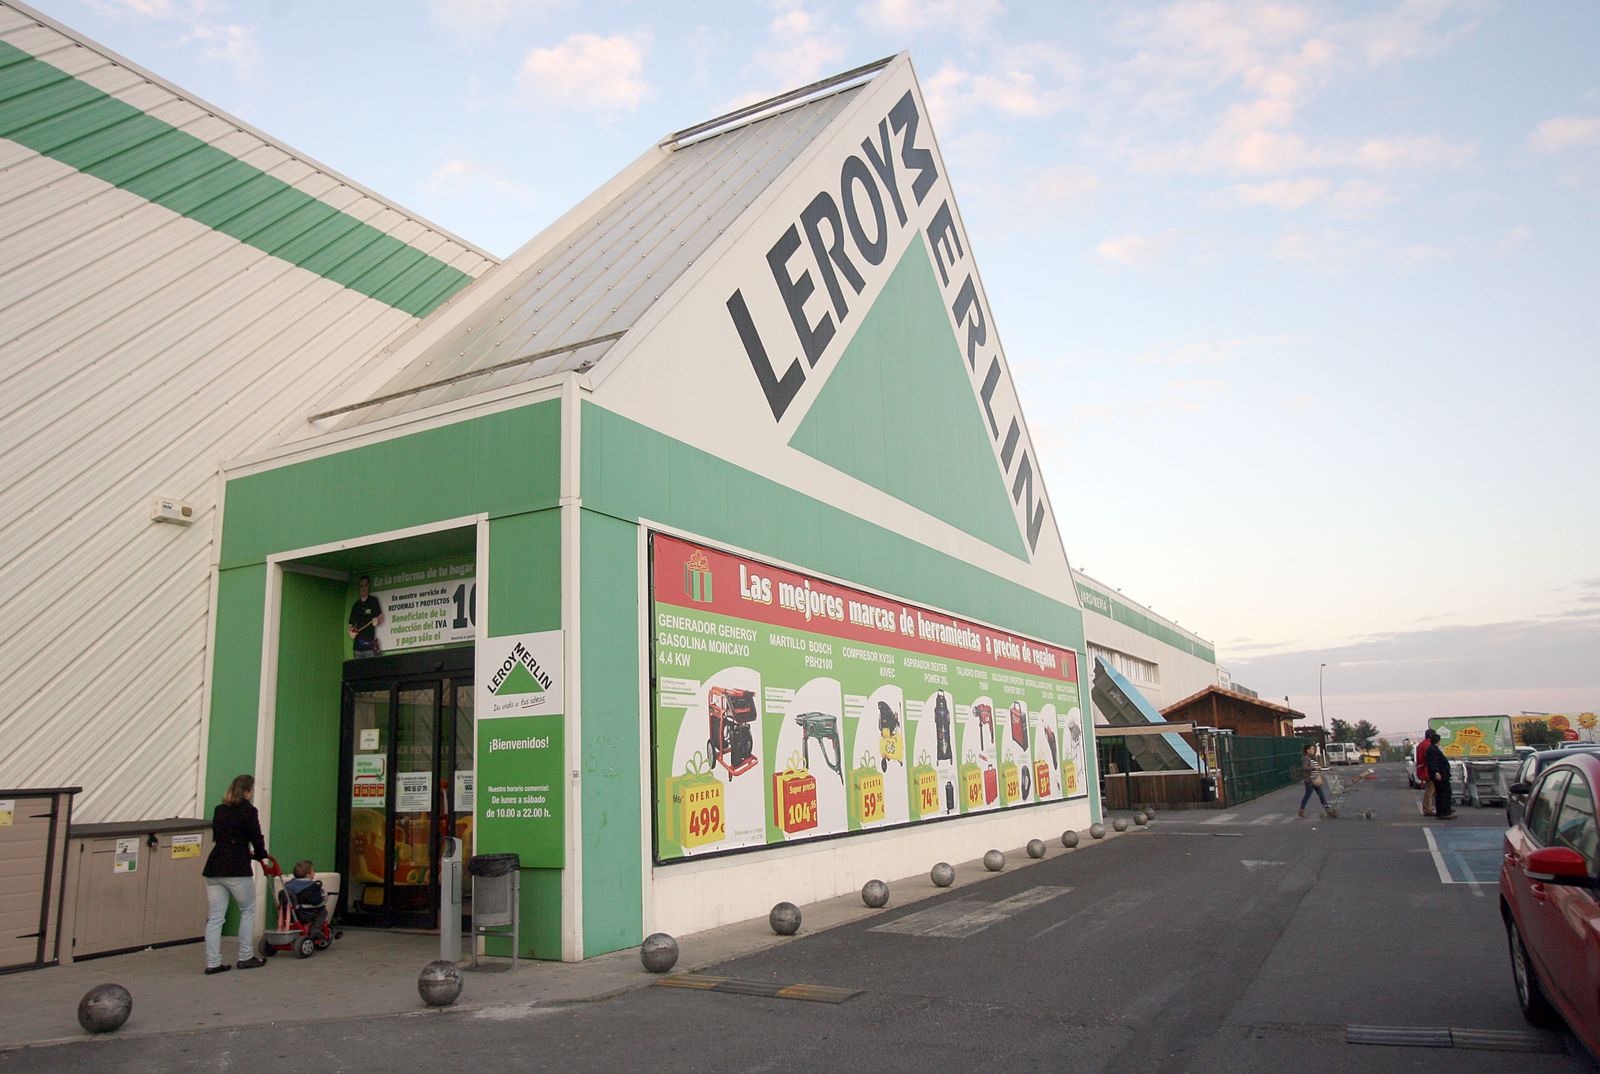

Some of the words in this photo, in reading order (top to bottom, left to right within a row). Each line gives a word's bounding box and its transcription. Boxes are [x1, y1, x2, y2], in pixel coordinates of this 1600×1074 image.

[726, 117, 909, 423] LEROY
[887, 88, 1046, 555] MERLIN
[385, 574, 392, 585] la
[394, 571, 426, 584] reforma
[426, 568, 438, 578] de
[439, 566, 448, 576] tu
[449, 564, 474, 576] hogar
[420, 589, 440, 598] servicio
[388, 602, 414, 612] REFORMAS
[420, 597, 450, 608] PROYECTOS
[430, 609, 438, 618] de
[439, 608, 446, 616] la
[738, 564, 772, 605] Las
[778, 579, 845, 622] mejores
[848, 600, 896, 632] marcas
[900, 607, 915, 638] de
[917, 611, 982, 653] herramientas
[985, 636, 992, 655] a
[993, 636, 1021, 662] precios
[1022, 640, 1032, 664] de
[423, 621, 434, 630] del
[436, 620, 447, 628] IVA
[658, 614, 716, 636] GENERADOR
[718, 622, 758, 642] GENERGY
[402, 638, 418, 646] paga
[659, 632, 708, 652] GASOLINA
[708, 640, 750, 658] MONCAYO
[770, 634, 806, 651] MARTILLO
[809, 640, 832, 655] BOSCH
[658, 651, 673, 666] 4.4
[675, 653, 690, 668] KW
[842, 646, 878, 662] COMPRESOR
[514, 642, 552, 691] MERLIN
[804, 656, 832, 670] PBH2100
[904, 657, 930, 670] ASPIRADOR
[487, 651, 516, 695] LEROY
[924, 673, 940, 684] POWER
[502, 700, 514, 710] vida
[490, 736, 549, 752] ¡Bienvenidos!
[790, 786, 801, 795] Super
[802, 781, 816, 792] precio
[864, 779, 881, 789] OFERTA
[523, 795, 546, 804] sábado
[690, 788, 720, 802] OFERTA
[486, 808, 495, 817] de
[496, 808, 515, 817] 10.00
[522, 808, 542, 817] 22.00
[544, 808, 551, 817] h.
[689, 805, 720, 836] 499
